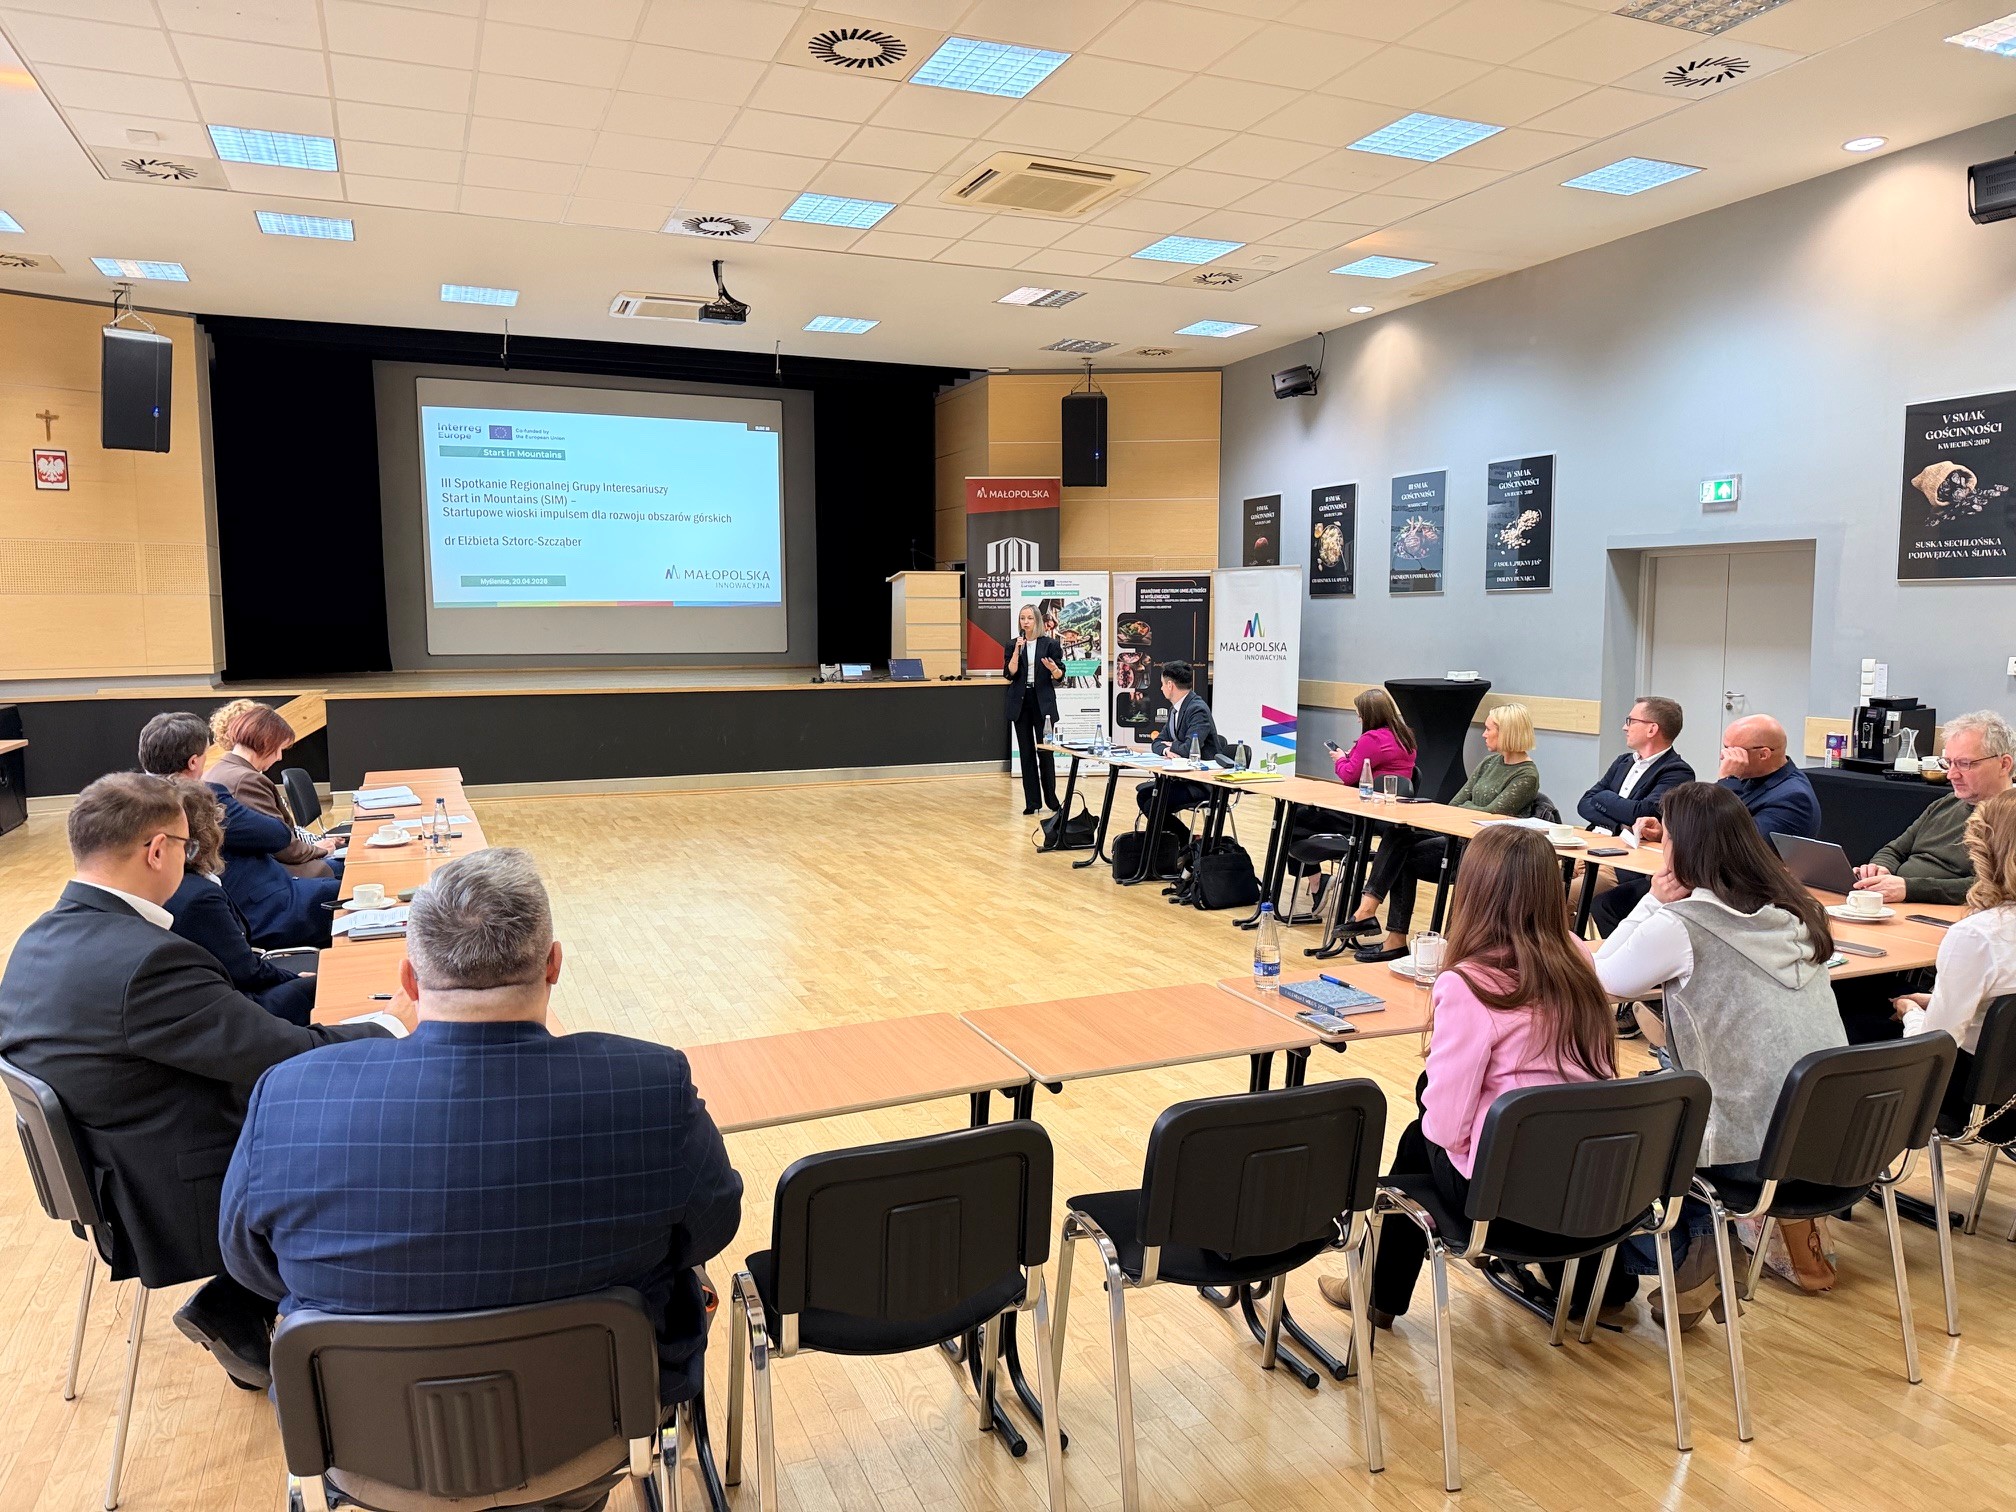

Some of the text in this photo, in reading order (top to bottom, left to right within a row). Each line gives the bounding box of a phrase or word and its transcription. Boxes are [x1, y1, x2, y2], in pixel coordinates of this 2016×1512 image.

[1942, 410, 1985, 424] V SMAK
[438, 422, 482, 433] Interreg
[1925, 422, 2002, 440] GOŚCINNOŚCI
[438, 432, 472, 440] Europe
[1938, 439, 1973, 450] KWIECIEŃ
[483, 449, 504, 457] Start
[517, 450, 562, 459] Mountains
[441, 478, 668, 496] III Spotkanie Regionalnej Grupy Interesariuszy
[442, 493, 468, 503] Start
[471, 494, 480, 503] in
[484, 494, 538, 504] Mountains
[541, 495, 568, 506] (SIM)
[989, 490, 1050, 498] MAŁOPOLSKA
[443, 507, 732, 524] Startupowe wioski impulsem dla rozwoju obszarów górskich
[444, 536, 582, 548] dr Elżbieta Sztorc-Szcząber
[1915, 540, 1943, 549] SUSKA
[1908, 548, 2007, 559] PODWĘDZANA ŚLIWKA
[684, 569, 770, 580] MAŁOPOLSKA
[1220, 642, 1287, 652] MAŁOPOLSKA
